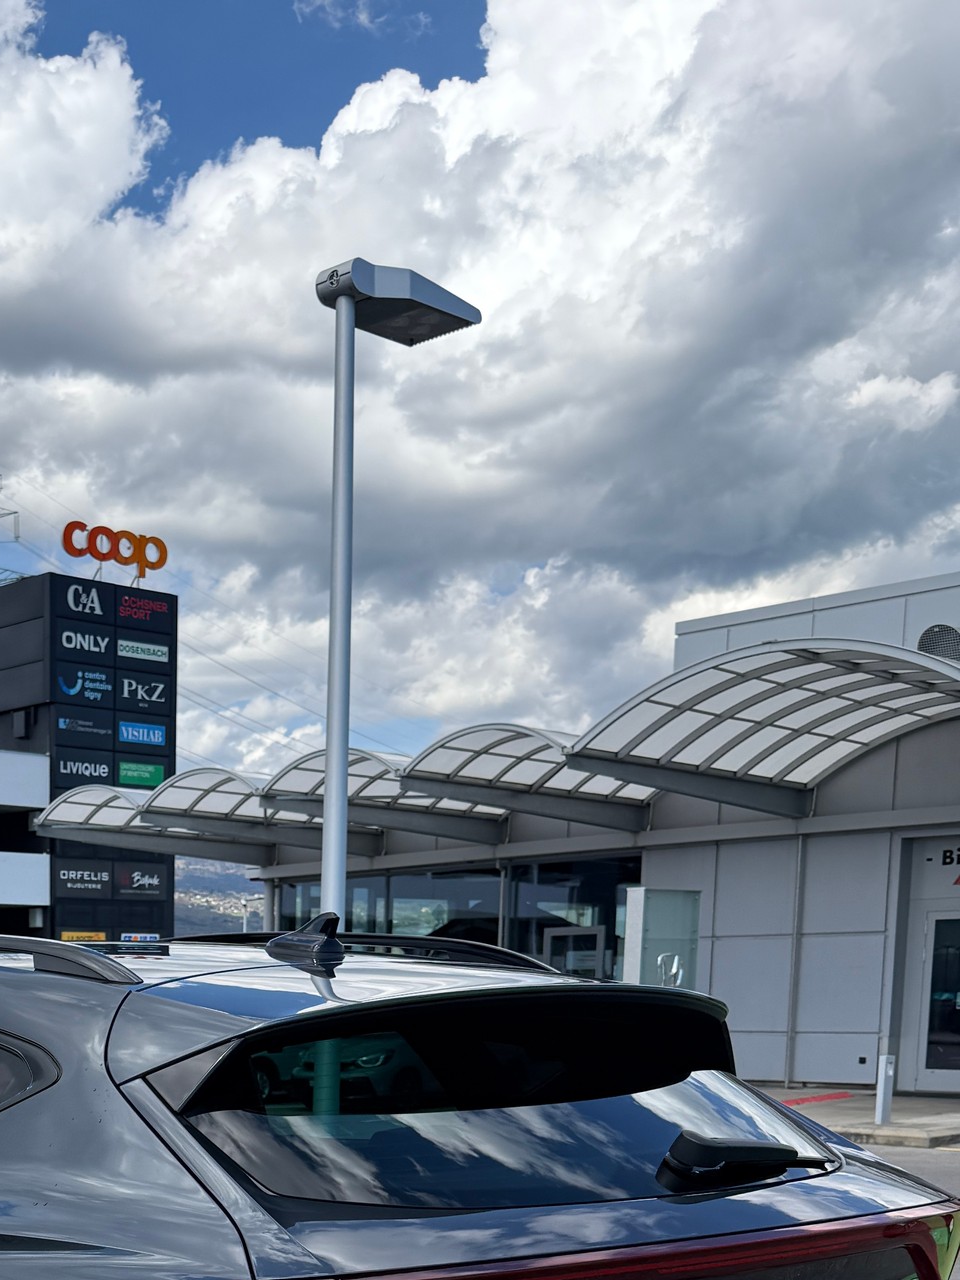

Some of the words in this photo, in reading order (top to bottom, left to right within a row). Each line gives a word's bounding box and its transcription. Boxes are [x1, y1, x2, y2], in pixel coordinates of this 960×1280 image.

[63, 520, 168, 579] coop
[66, 584, 104, 616] C&A
[122, 595, 168, 613] OCHSNER
[119, 606, 151, 621] SPORT
[61, 631, 110, 653] ONLY
[119, 644, 167, 658] DOSENBACH
[84, 671, 106, 680] centre
[84, 680, 112, 691] dentaire
[120, 726, 163, 743] VISILAB
[60, 870, 109, 881] ORFELIS
